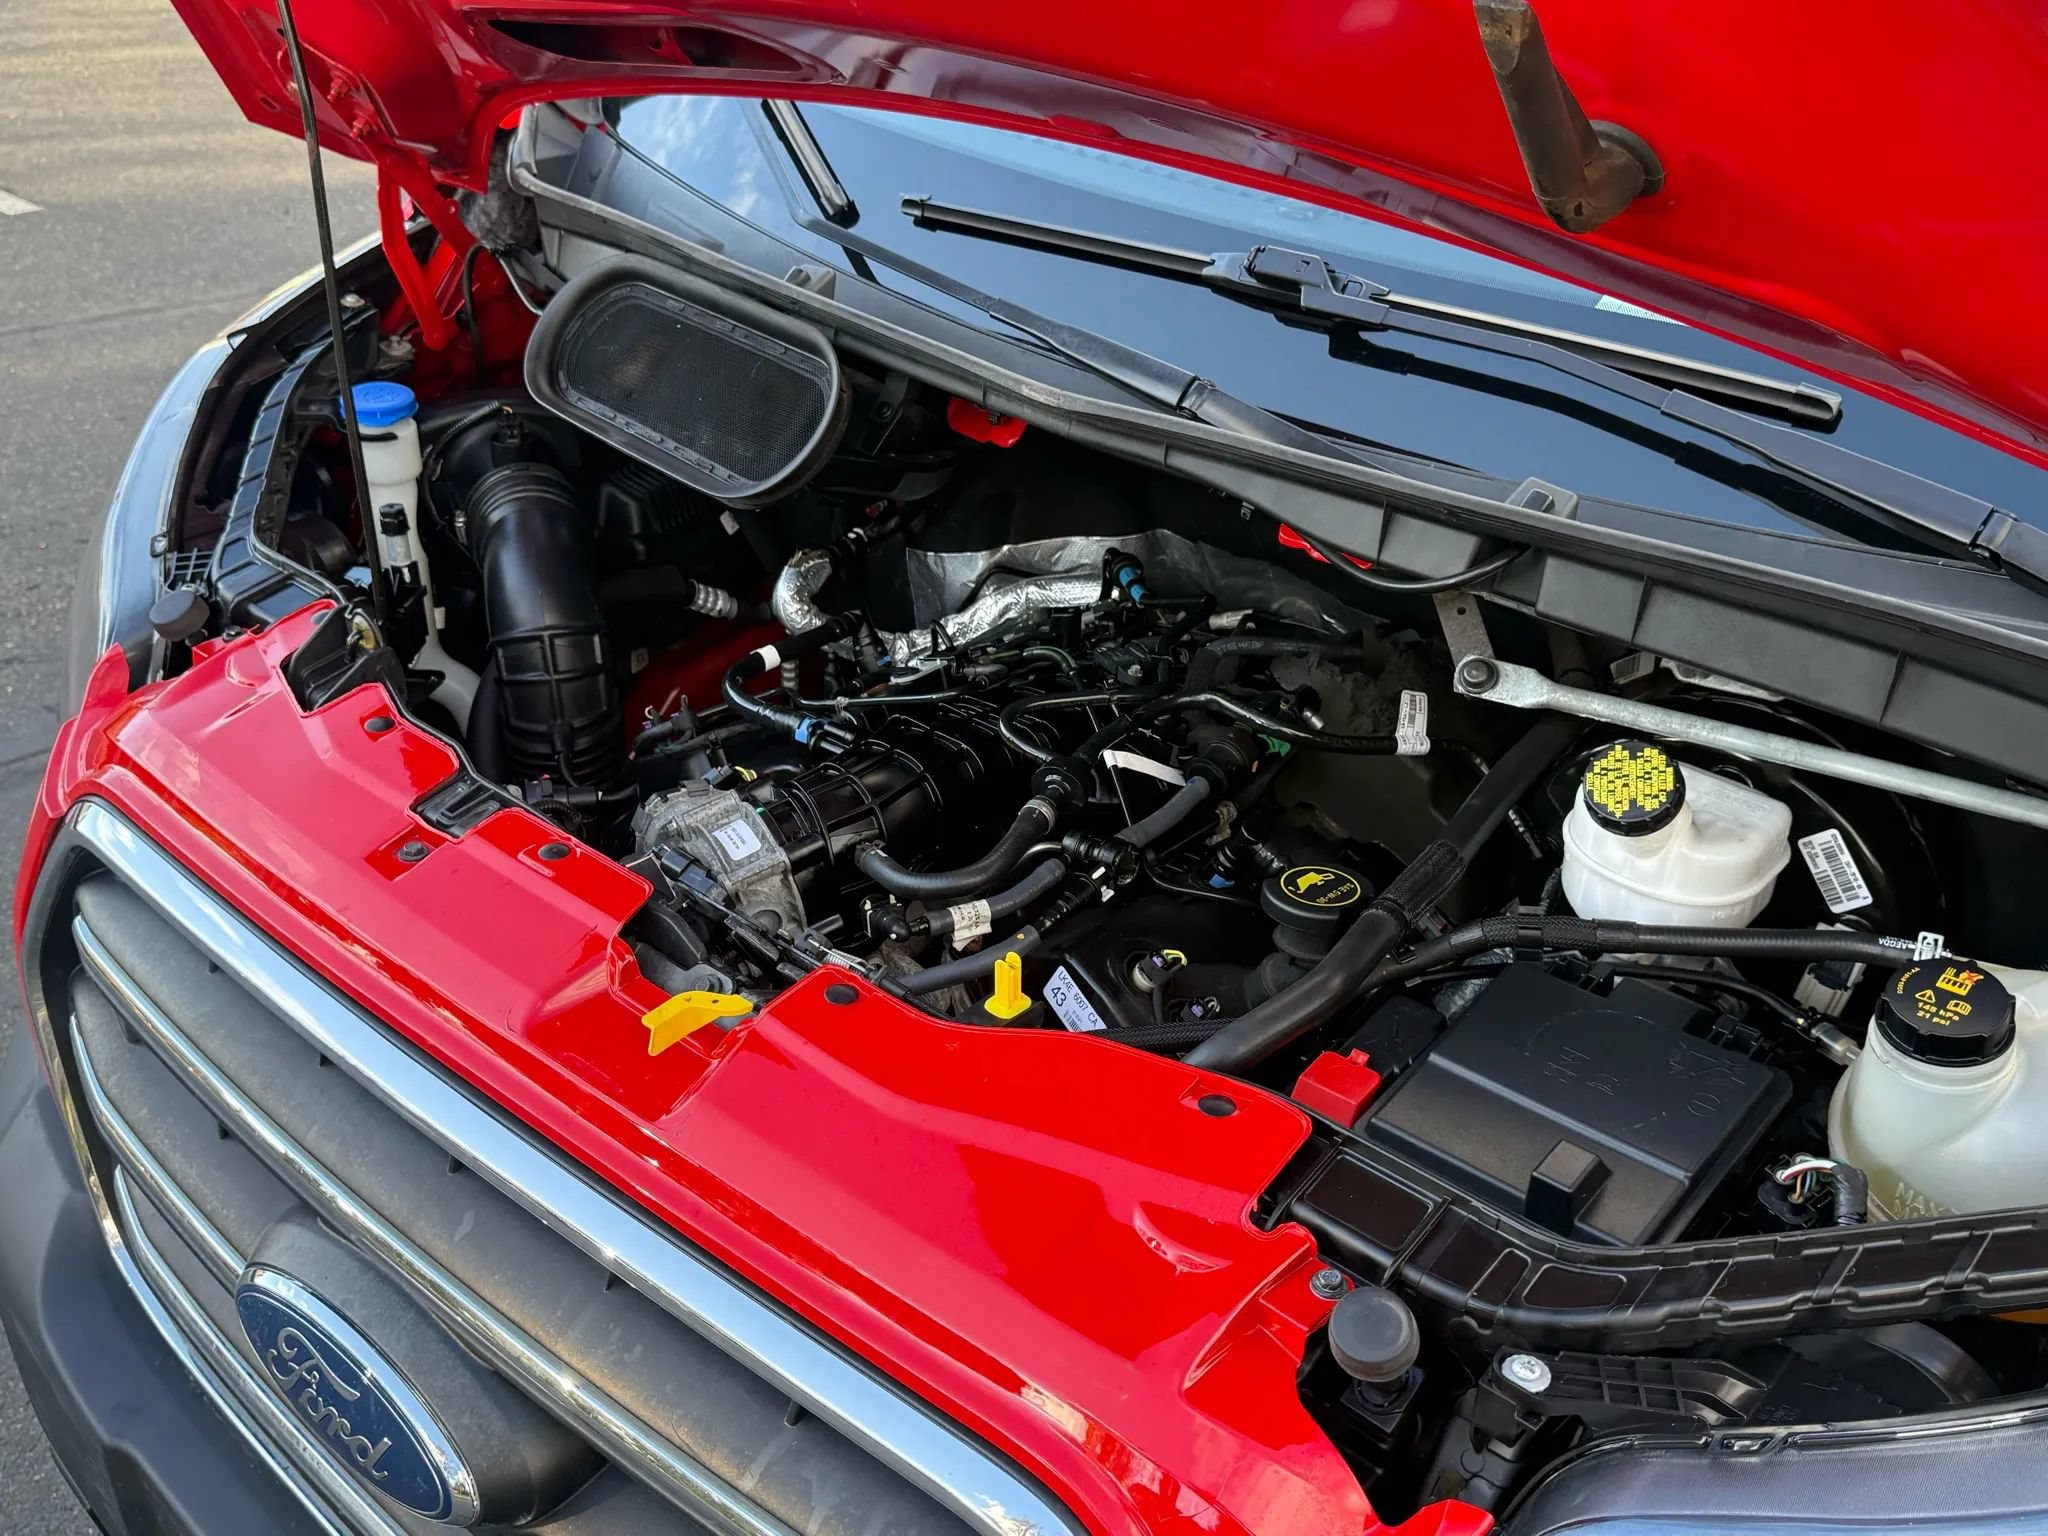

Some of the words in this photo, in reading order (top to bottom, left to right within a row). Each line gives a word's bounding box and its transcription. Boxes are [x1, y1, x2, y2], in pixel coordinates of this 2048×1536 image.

[1051, 987, 1067, 1007] 43
[1058, 971, 1074, 993] LK4E
[1074, 993, 1089, 1011] 6007
[1917, 1002, 1937, 1012] 145
[1939, 1008, 1960, 1021] kPa
[1917, 1010, 1930, 1019] 21
[1932, 1017, 1950, 1026] psi
[267, 1327, 392, 1480] Ford
